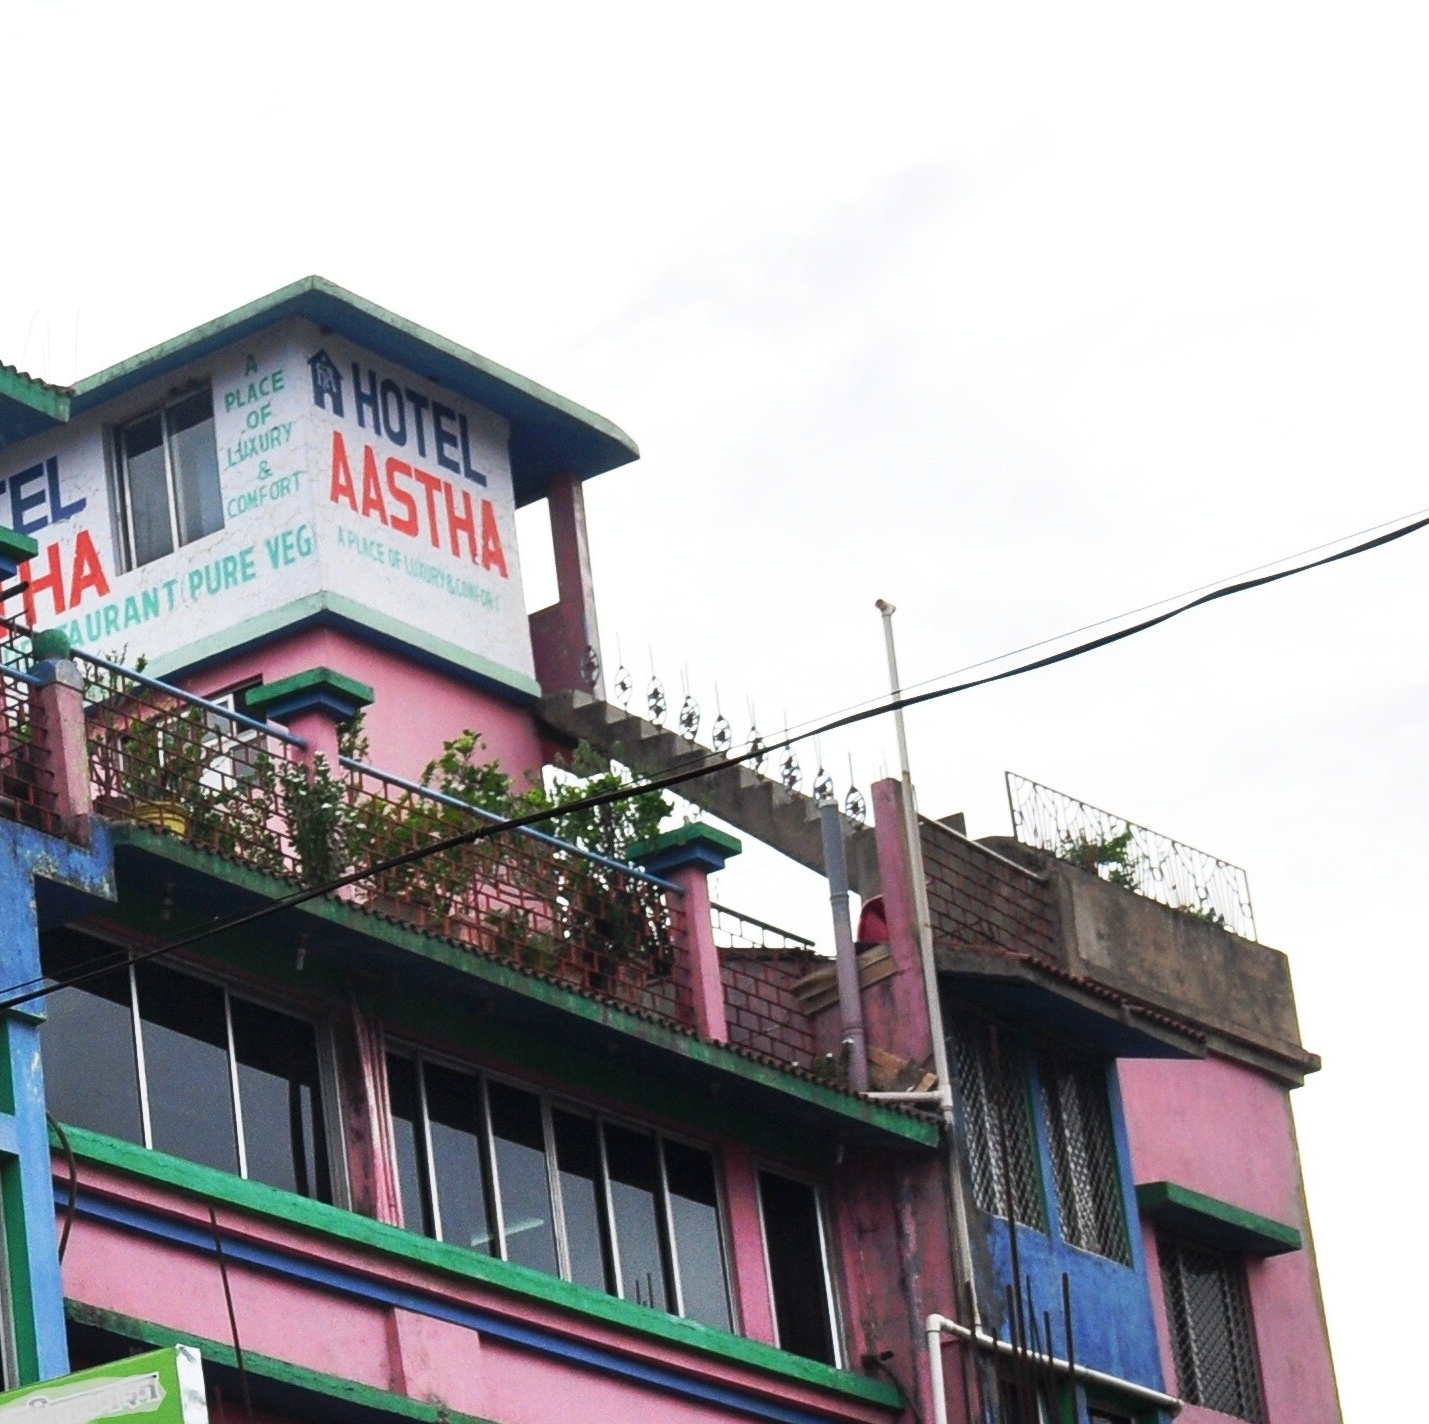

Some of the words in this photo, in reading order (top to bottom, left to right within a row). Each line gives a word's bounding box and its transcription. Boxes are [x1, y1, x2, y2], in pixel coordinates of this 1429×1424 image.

[245, 354, 258, 377] A
[225, 370, 285, 412] PLACE
[246, 402, 272, 429] OF
[351, 361, 488, 487] HOTEL
[227, 421, 293, 467] LUXURY
[227, 470, 304, 518] COMFORT
[330, 431, 509, 579] AASTHA
